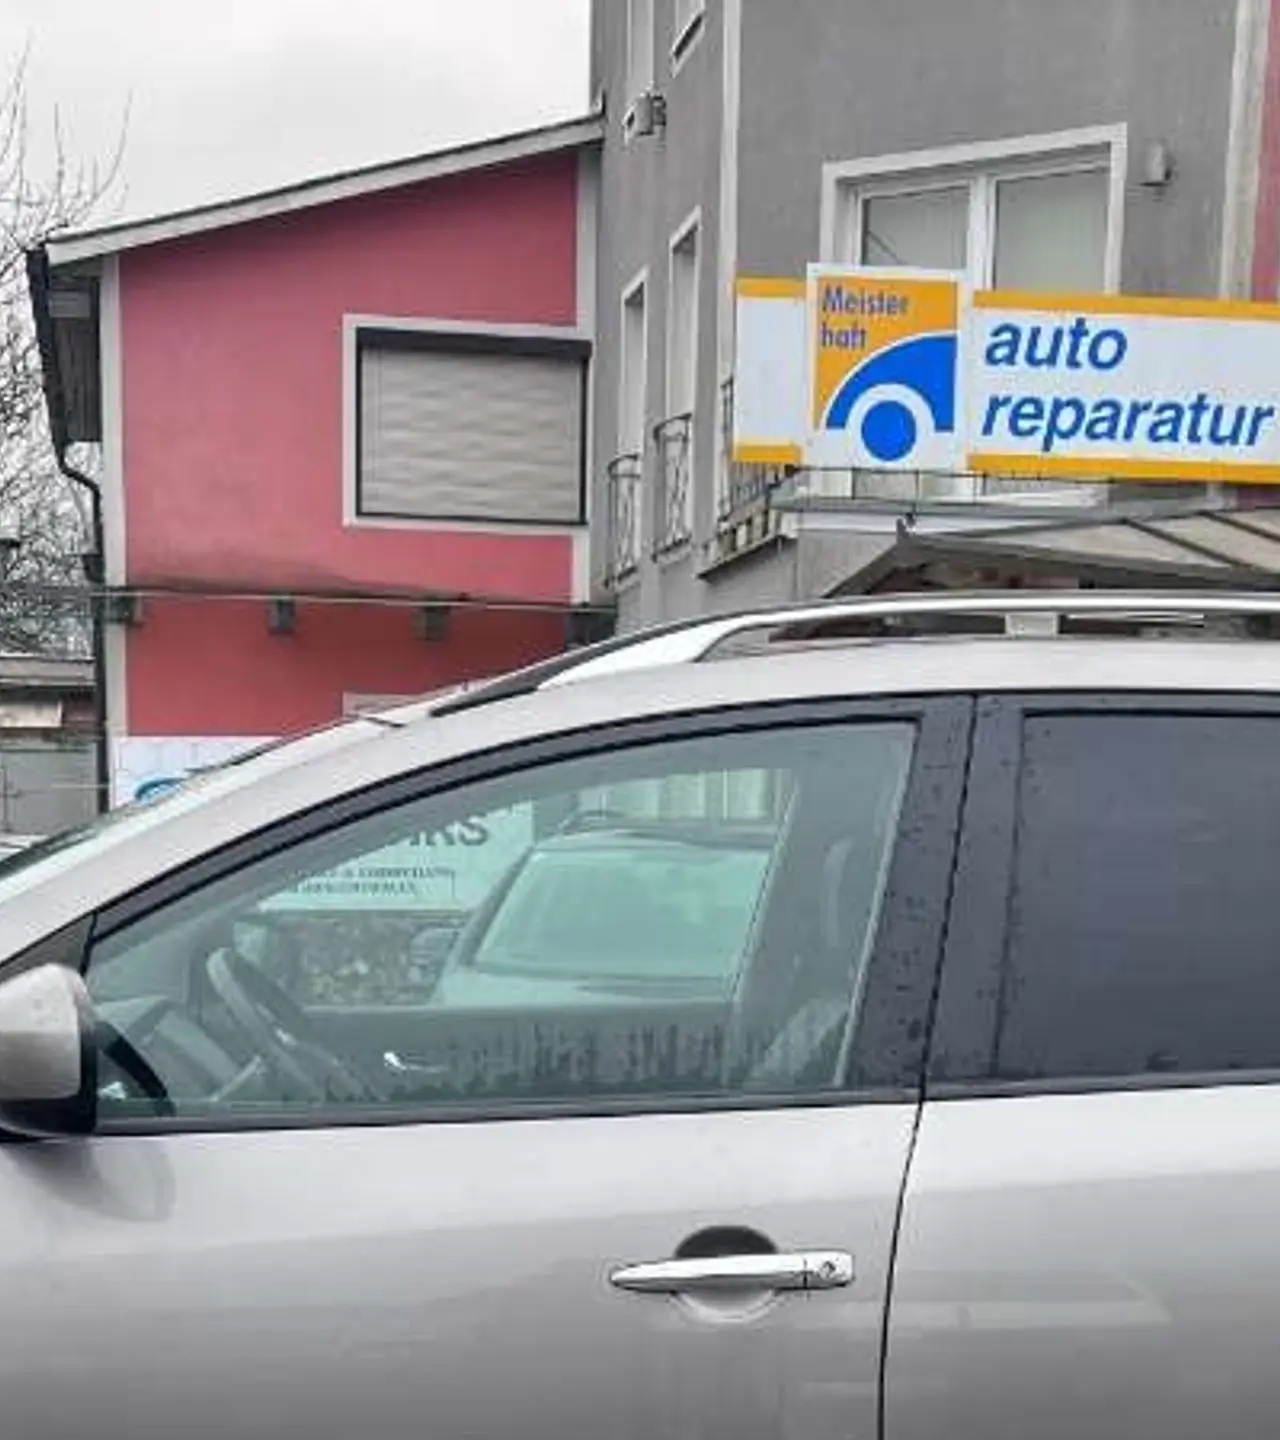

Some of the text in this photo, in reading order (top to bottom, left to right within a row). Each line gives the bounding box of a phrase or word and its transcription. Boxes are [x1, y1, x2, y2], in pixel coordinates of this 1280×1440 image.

[822, 283, 910, 316] Meister
[985, 316, 1128, 370] auto
[981, 392, 1275, 453] reparatur
